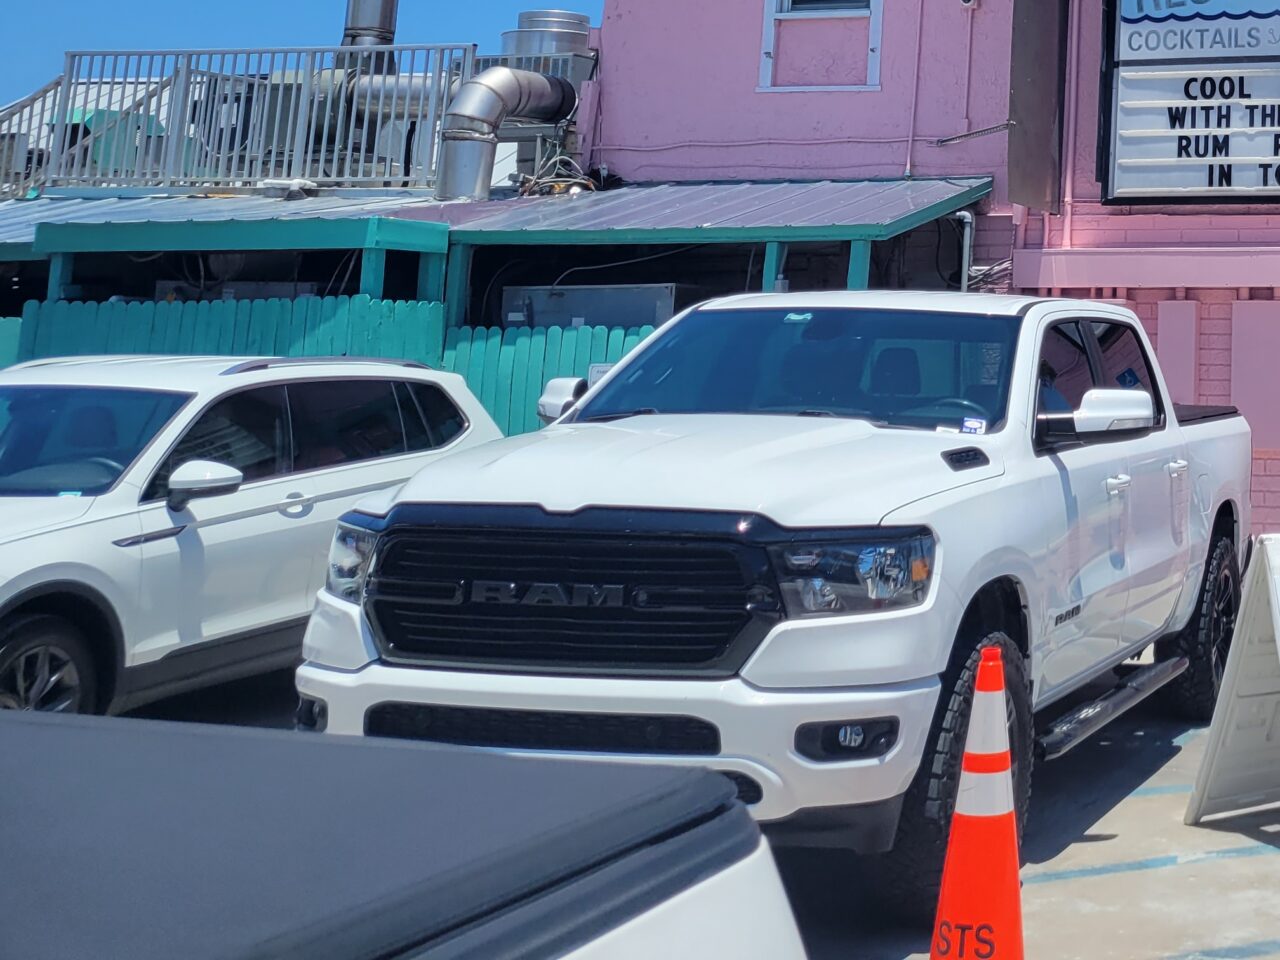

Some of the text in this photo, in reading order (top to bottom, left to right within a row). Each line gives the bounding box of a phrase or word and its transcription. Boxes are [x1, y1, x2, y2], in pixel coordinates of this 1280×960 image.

[1127, 26, 1262, 52] COCKTAILS
[1183, 76, 1252, 100] COOL
[1167, 105, 1232, 130] WITH
[1177, 134, 1230, 158] RUM
[1207, 164, 1232, 188] IN
[470, 580, 624, 607] RAM
[1054, 603, 1082, 628] RAM
[936, 921, 996, 959] STS
